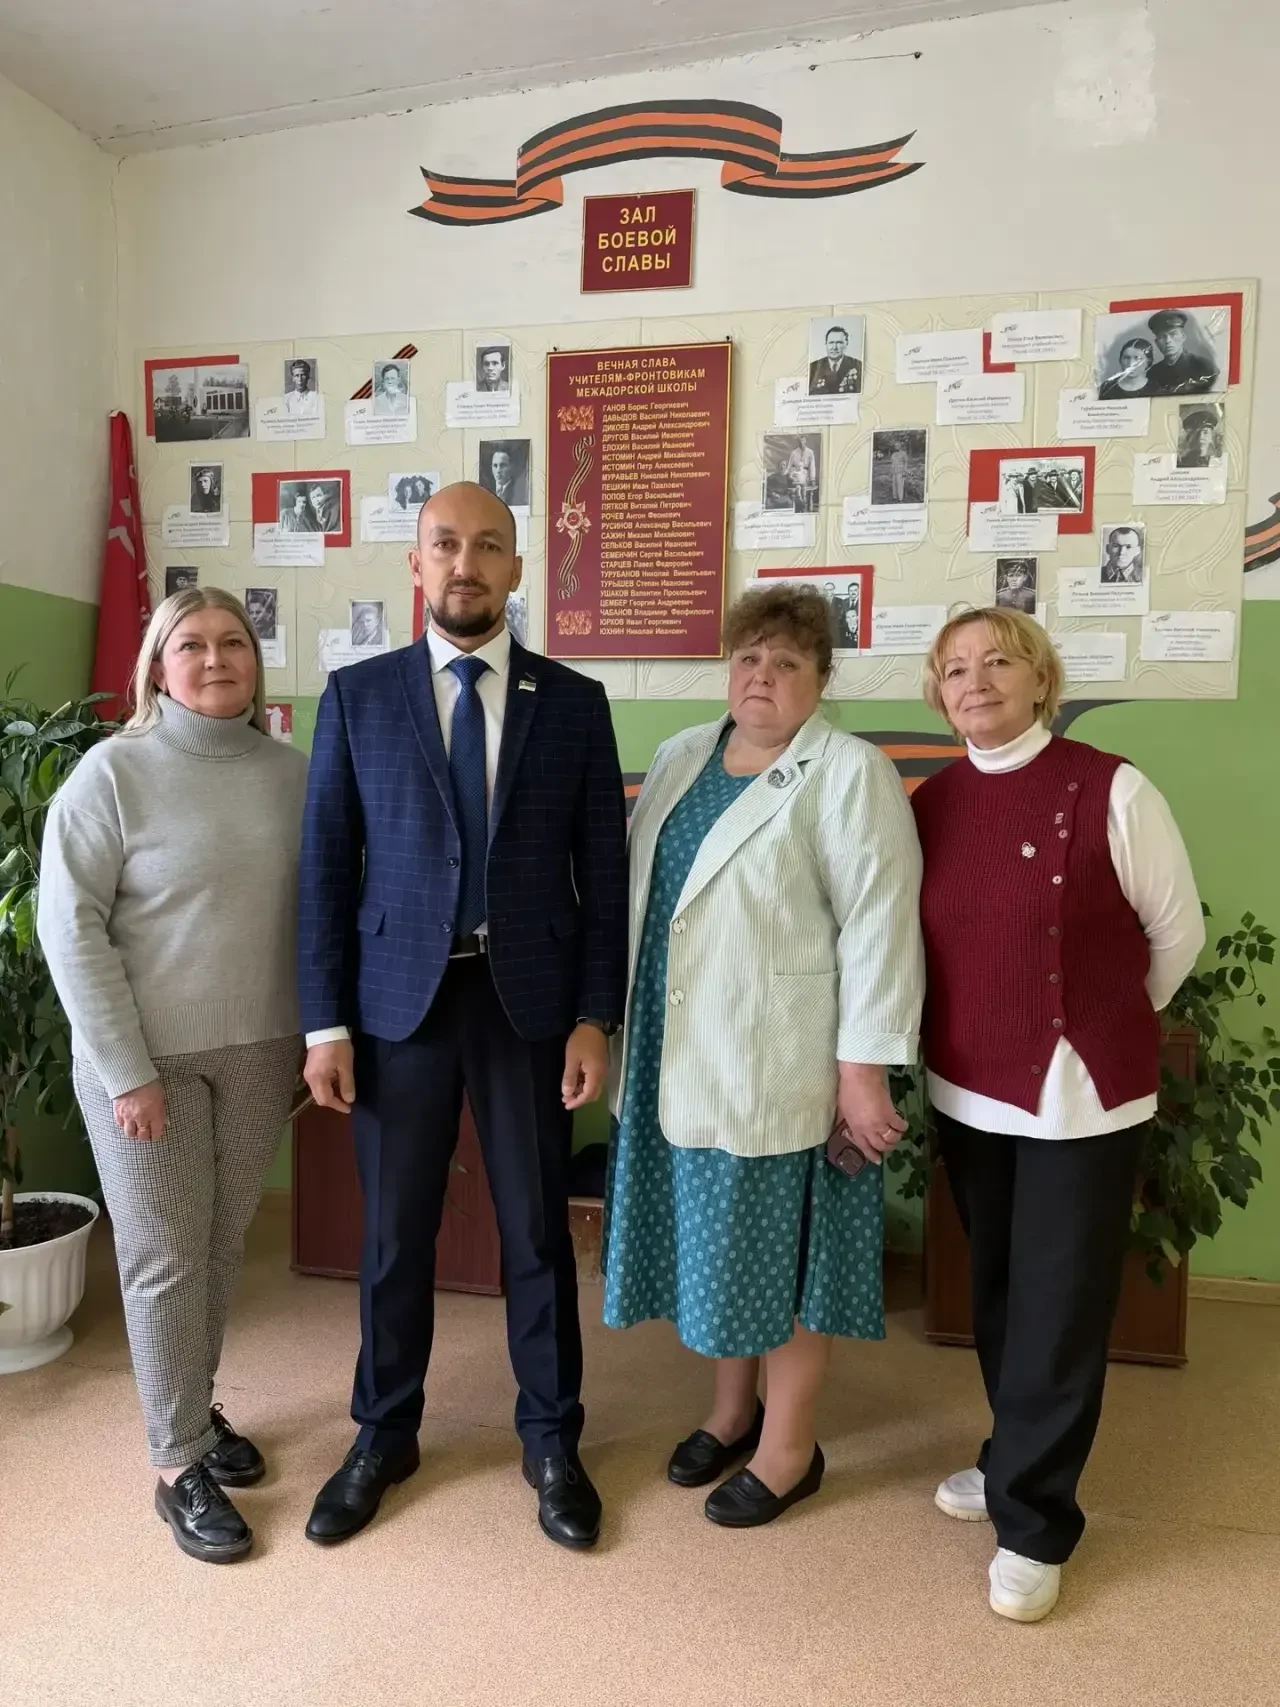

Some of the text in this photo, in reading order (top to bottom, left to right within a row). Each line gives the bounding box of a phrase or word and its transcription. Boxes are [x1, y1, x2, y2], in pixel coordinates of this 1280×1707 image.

[620, 206, 656, 224] ЗАЛ
[598, 225, 676, 249] БОЕВОЙ
[602, 253, 670, 272] СЛАВЫ
[597, 357, 676, 370] ВЕЧНАЯ СЛАВА
[569, 368, 704, 384] УЧИТЕЛЯМ-ФРОНТОВИКАМ
[576, 381, 696, 397] МЕЖАДОРСКОЙ ШКОЛЫ
[650, 401, 688, 410] Георгиевич
[602, 413, 637, 421] ДАВЫДОВ
[631, 422, 656, 430] Андрей
[658, 420, 709, 429] Александрович
[602, 433, 629, 441] ДРУГОВ
[602, 452, 635, 461] ИСТОМИН
[602, 462, 635, 470] ИСТОМИН
[644, 490, 684, 498] Васильевич
[659, 500, 691, 508] Петрович
